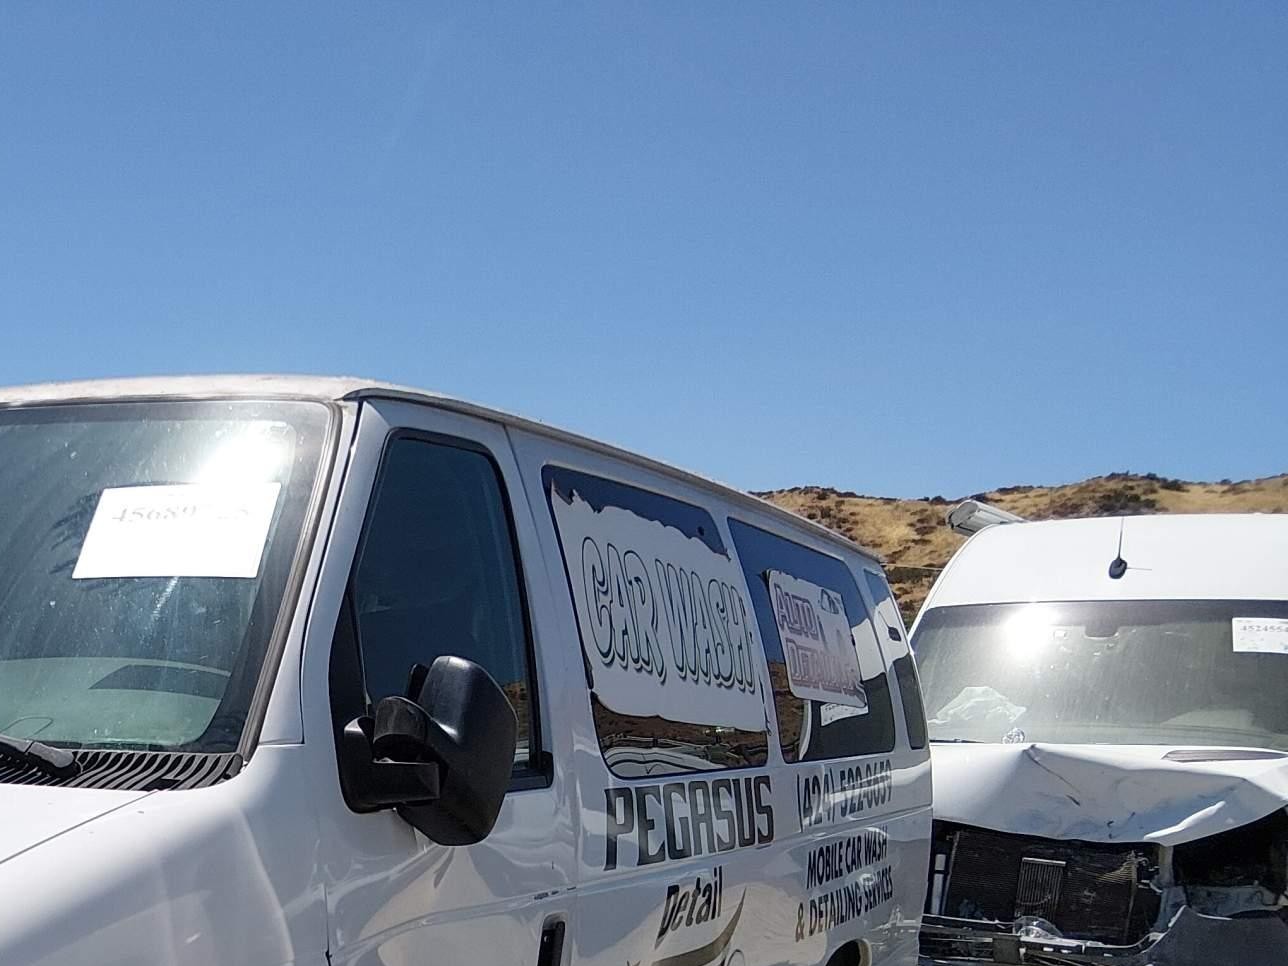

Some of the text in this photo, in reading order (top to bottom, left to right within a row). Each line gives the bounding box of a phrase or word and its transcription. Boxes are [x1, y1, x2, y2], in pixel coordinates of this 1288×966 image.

[581, 536, 755, 694] CAR WASH
[603, 775, 775, 871] PEGASUS
[797, 768, 836, 833] (424)
[807, 825, 887, 889] MOBILE CAR WASH
[654, 866, 723, 949] Detail
[795, 902, 805, 942] &
[809, 881, 862, 936] DETAILING
